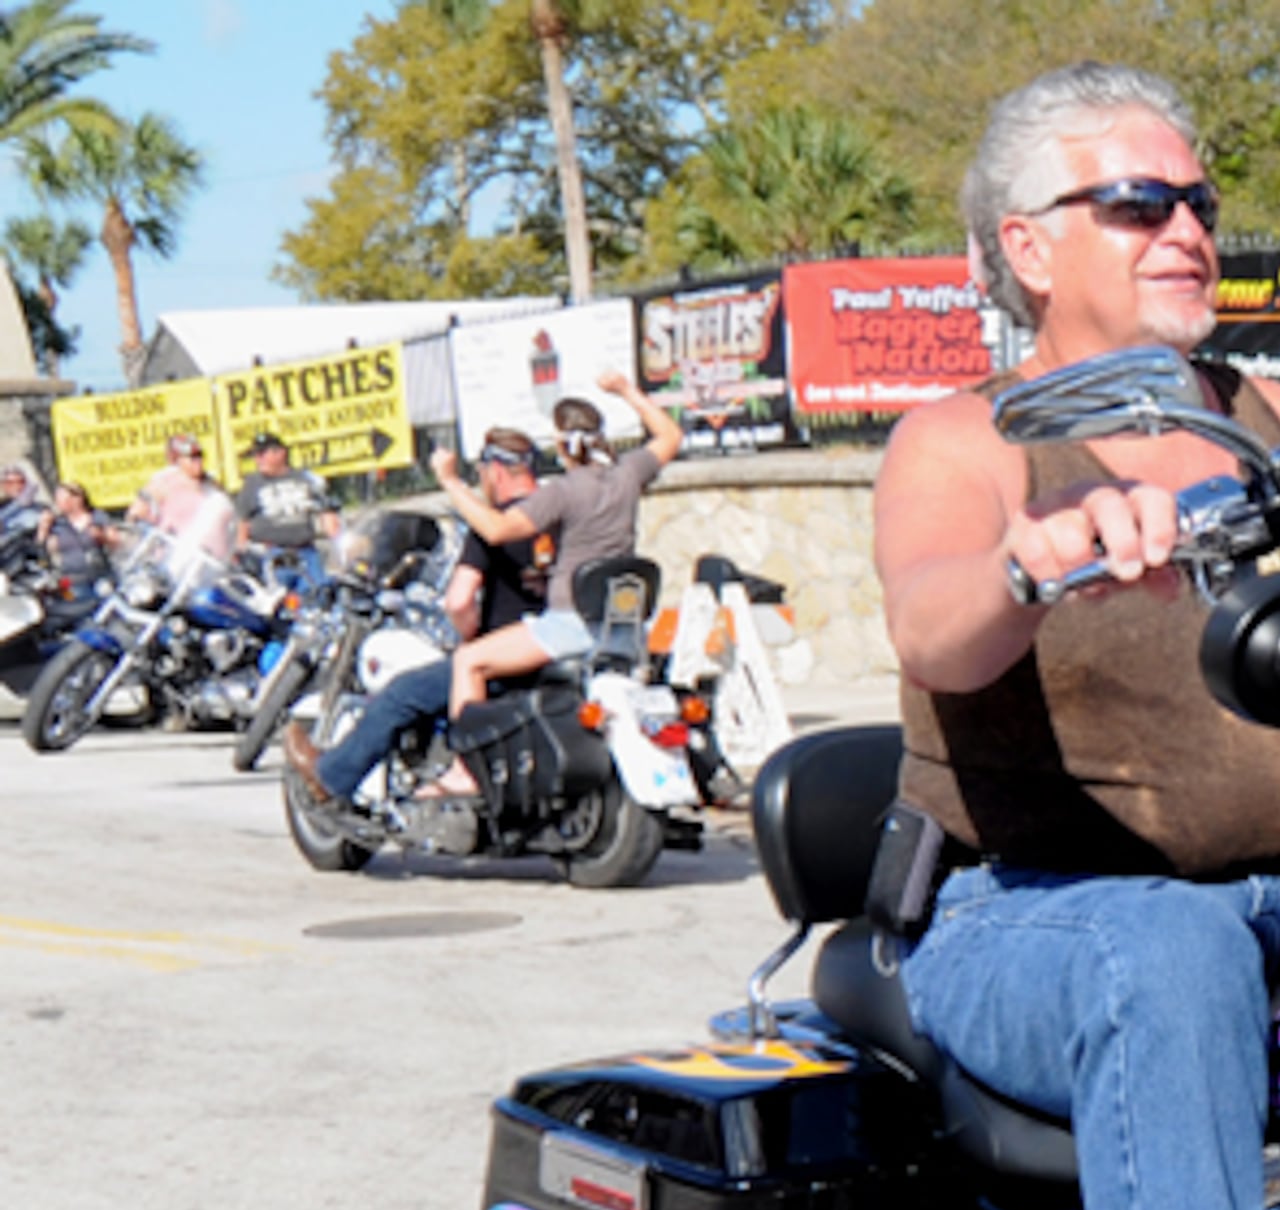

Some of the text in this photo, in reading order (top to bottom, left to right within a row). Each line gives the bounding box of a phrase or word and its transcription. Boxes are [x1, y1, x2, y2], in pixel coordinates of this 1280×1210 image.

[831, 286, 892, 311] Paul
[834, 312, 981, 347] Bagger
[855, 344, 992, 376] Nation
[227, 351, 395, 419] PATCHES
